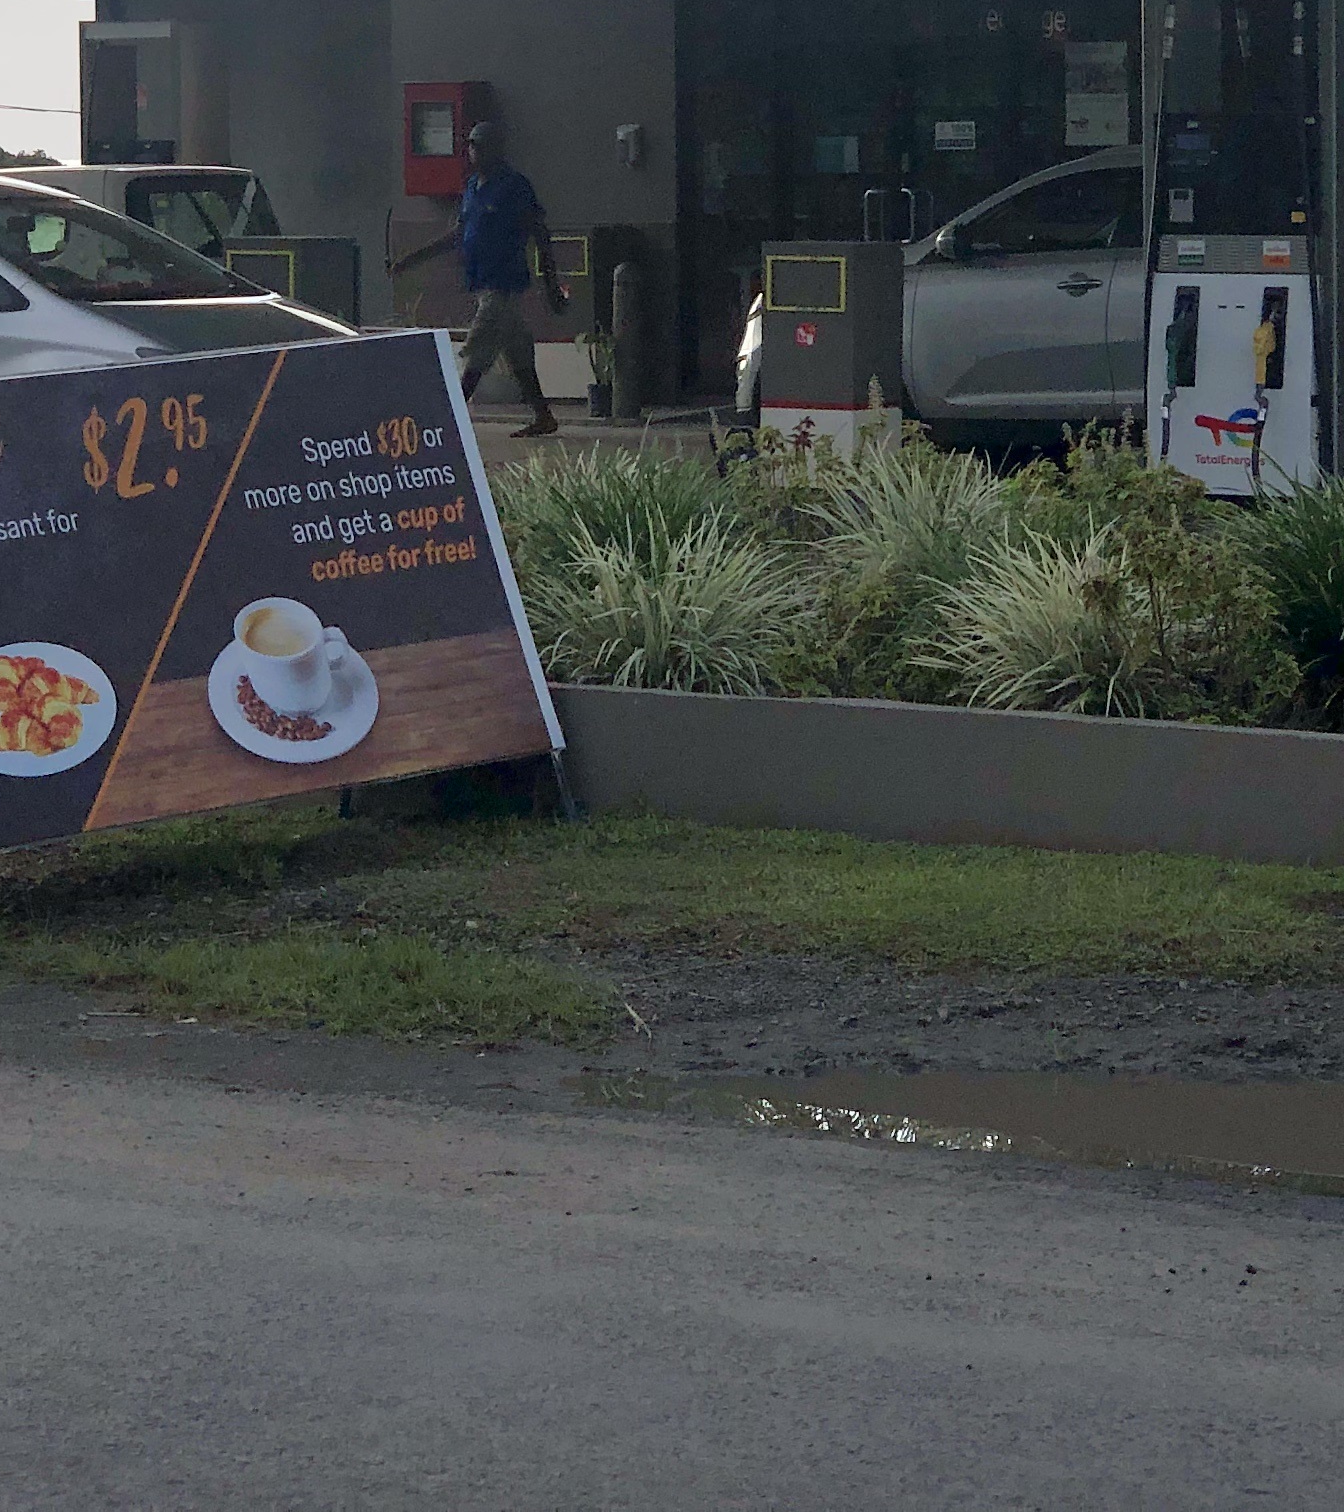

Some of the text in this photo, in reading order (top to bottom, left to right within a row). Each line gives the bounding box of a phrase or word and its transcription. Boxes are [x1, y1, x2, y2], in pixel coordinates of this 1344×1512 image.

[301, 416, 445, 467] Spend $30 or
[1195, 453, 1266, 467] TotalEnergs
[244, 464, 456, 509] more on shop items
[46, 508, 80, 535] for
[291, 496, 466, 544] and get a cup of
[311, 534, 478, 582] coffee for free!
